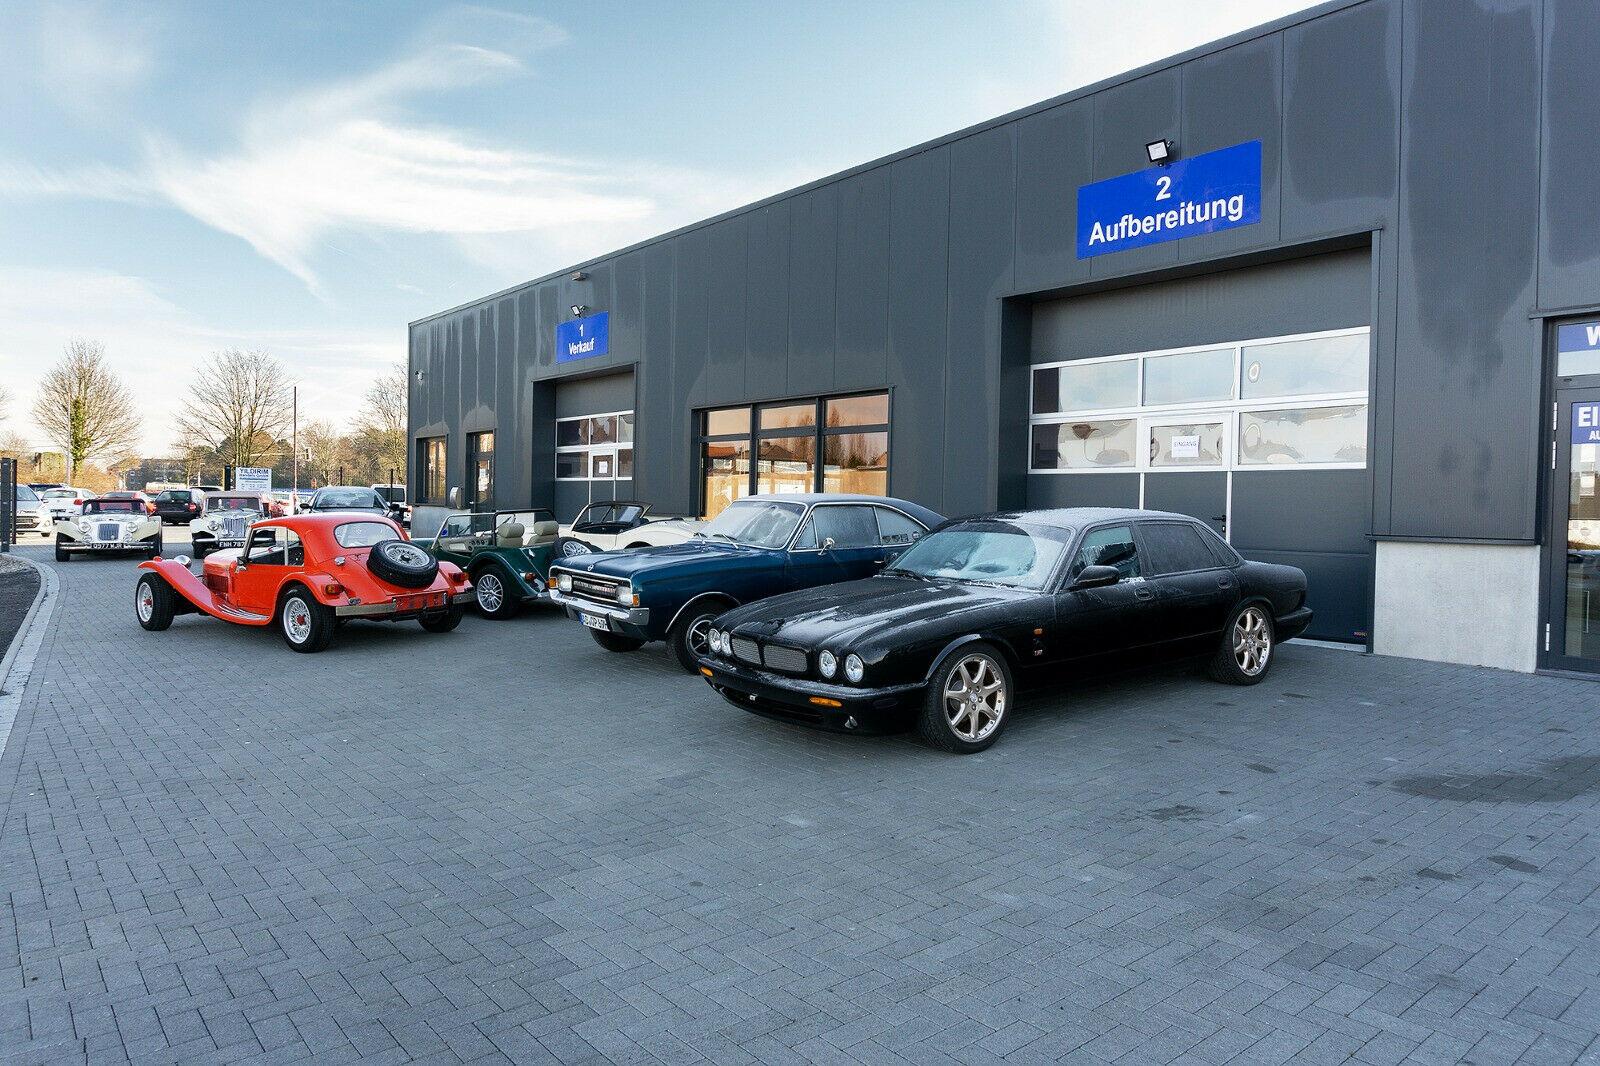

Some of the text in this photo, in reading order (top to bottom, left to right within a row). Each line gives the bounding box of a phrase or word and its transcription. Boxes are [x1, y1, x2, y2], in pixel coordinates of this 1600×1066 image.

[1155, 175, 1172, 202] 2
[1088, 194, 1244, 246] Aufbereitung
[579, 324, 584, 337] 1
[568, 338, 594, 355] Verkauf
